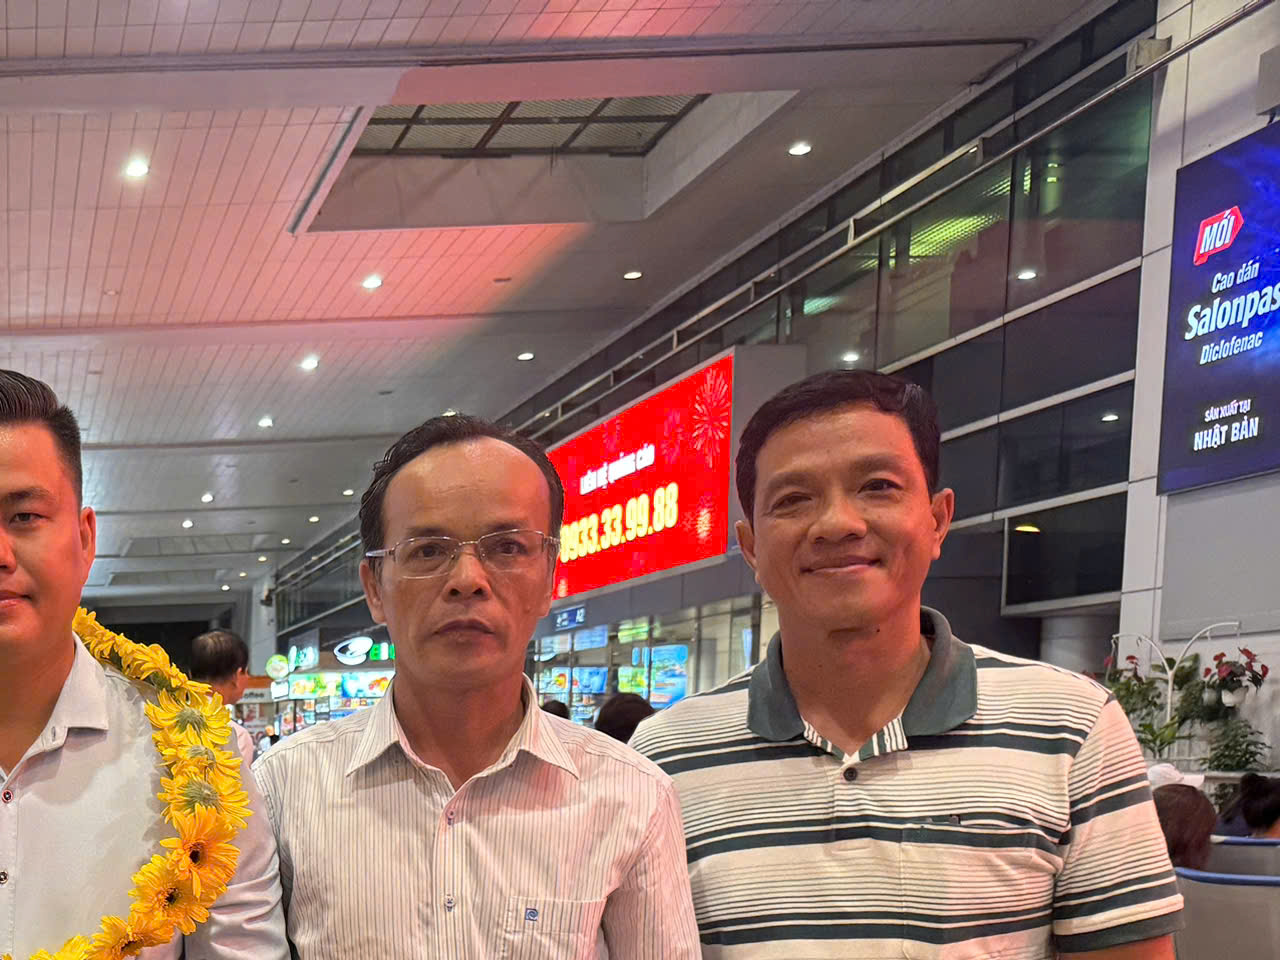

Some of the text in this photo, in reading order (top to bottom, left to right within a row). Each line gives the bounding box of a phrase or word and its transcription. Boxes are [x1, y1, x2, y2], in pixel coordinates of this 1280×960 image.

[1200, 209, 1236, 254] MỚI
[1211, 260, 1260, 293] Cao dán
[1199, 331, 1264, 365] Diclofenac
[1193, 415, 1259, 451] NHẬT BẢN
